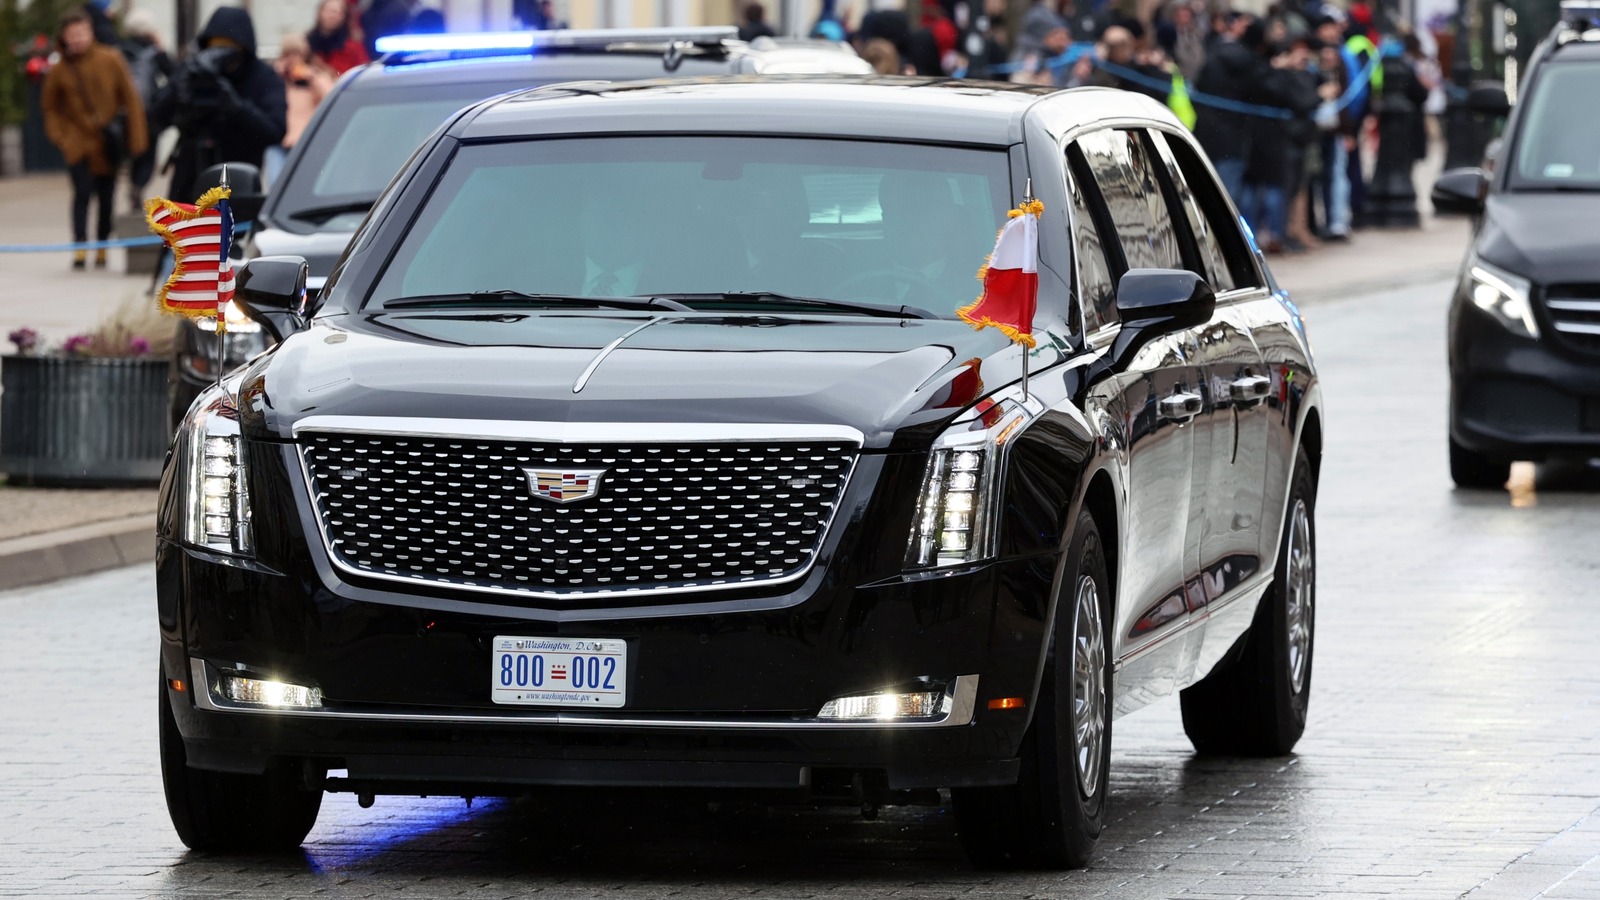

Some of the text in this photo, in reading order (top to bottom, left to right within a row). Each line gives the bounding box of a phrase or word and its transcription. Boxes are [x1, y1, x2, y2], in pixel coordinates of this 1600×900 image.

[525, 640, 572, 651] Washington,
[500, 654, 616, 689] 800 002
[526, 692, 592, 703] www.washingtondc.gov
